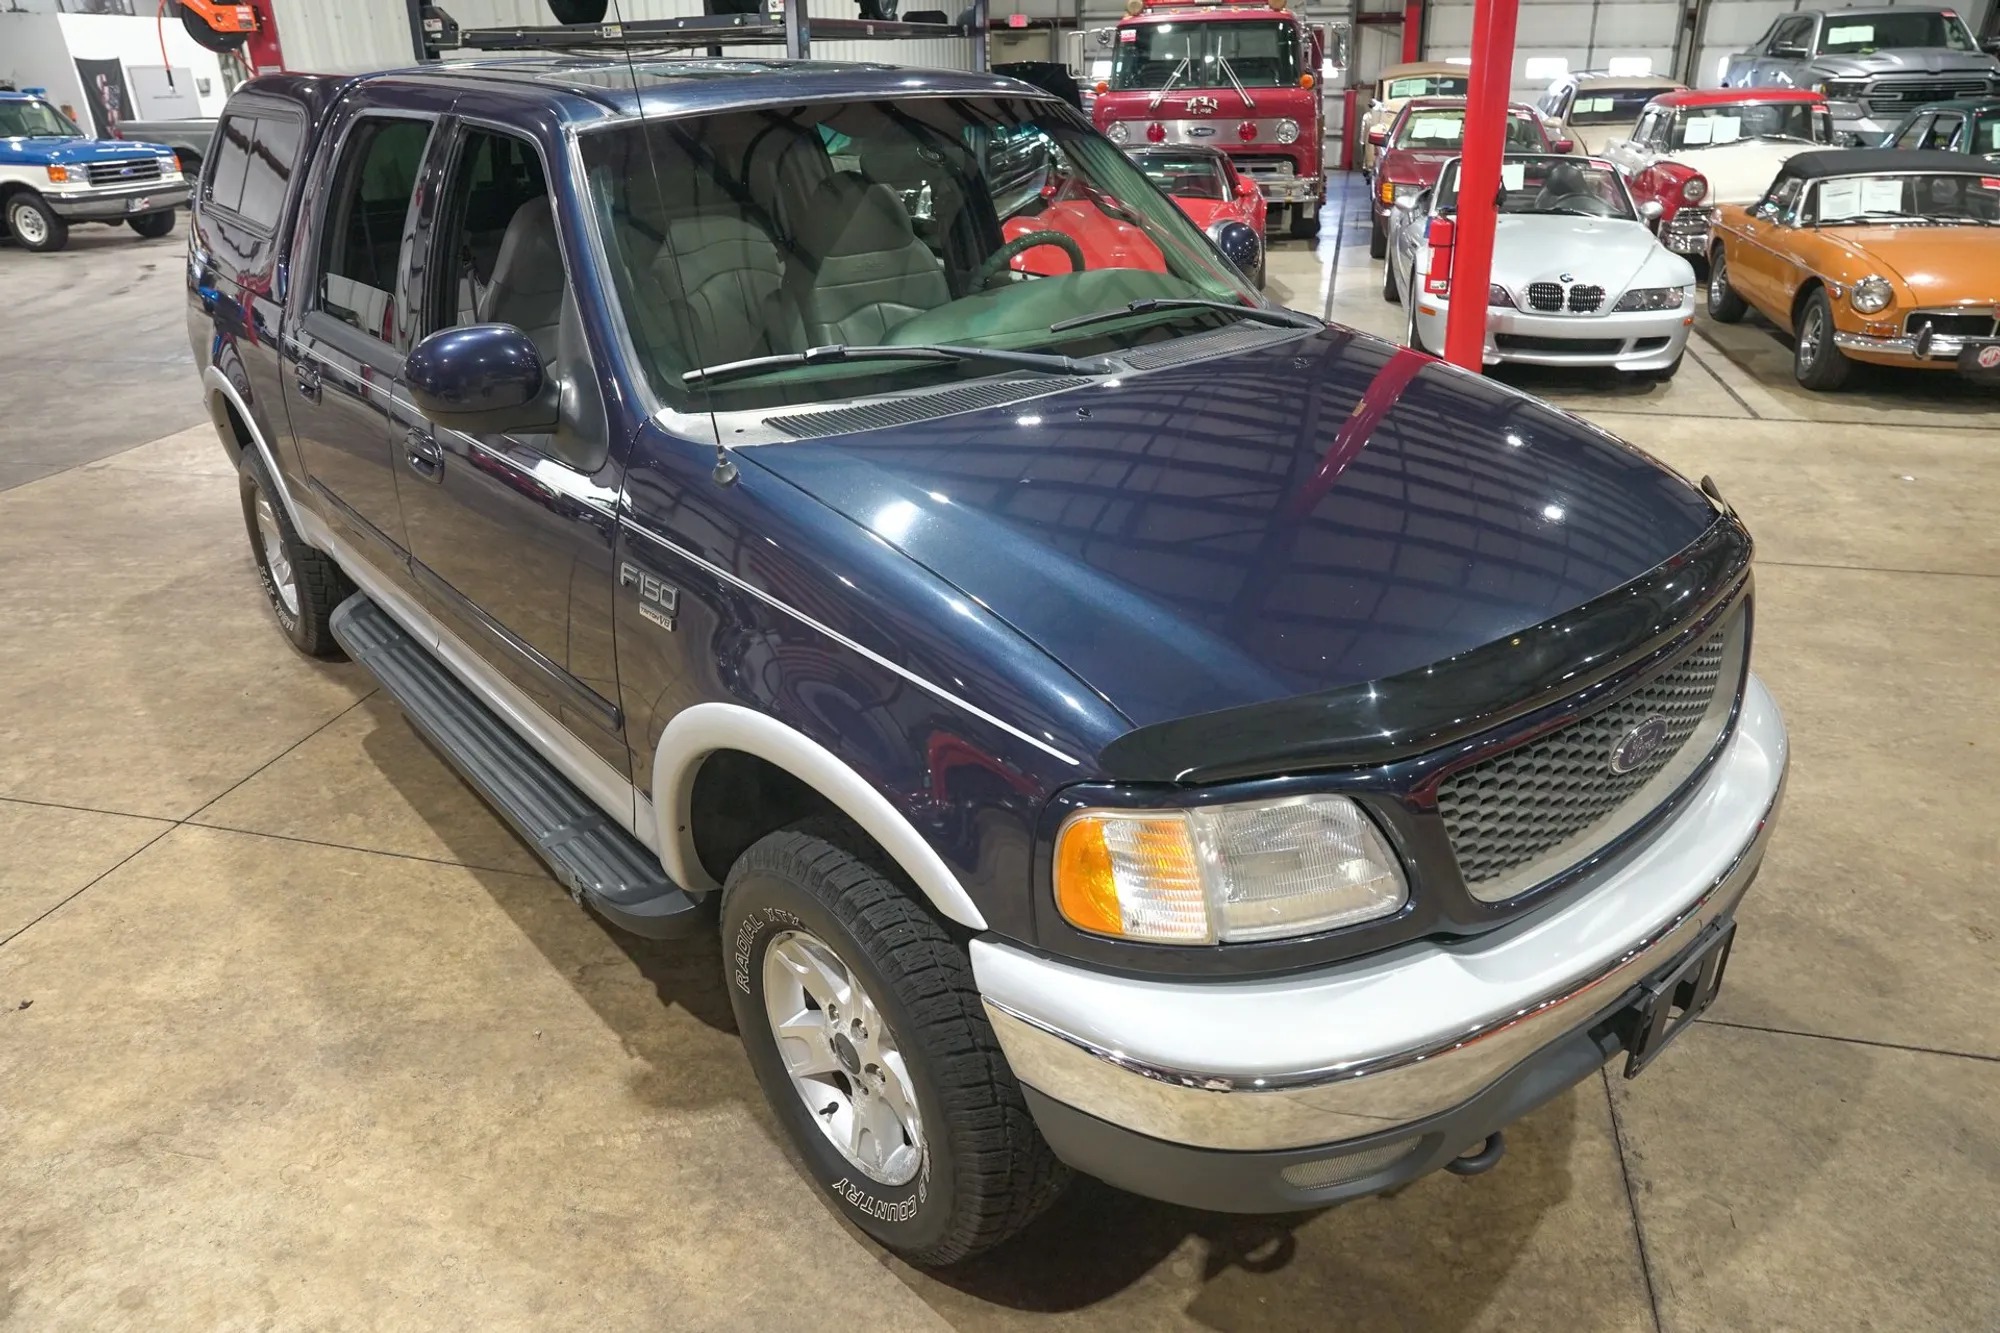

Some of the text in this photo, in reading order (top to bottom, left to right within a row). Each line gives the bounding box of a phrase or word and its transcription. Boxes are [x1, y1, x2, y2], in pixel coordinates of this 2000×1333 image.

[640, 606, 670, 628] TRITON V8
[735, 914, 764, 995] RADIAL
[832, 1178, 918, 1222] COUNTRY
